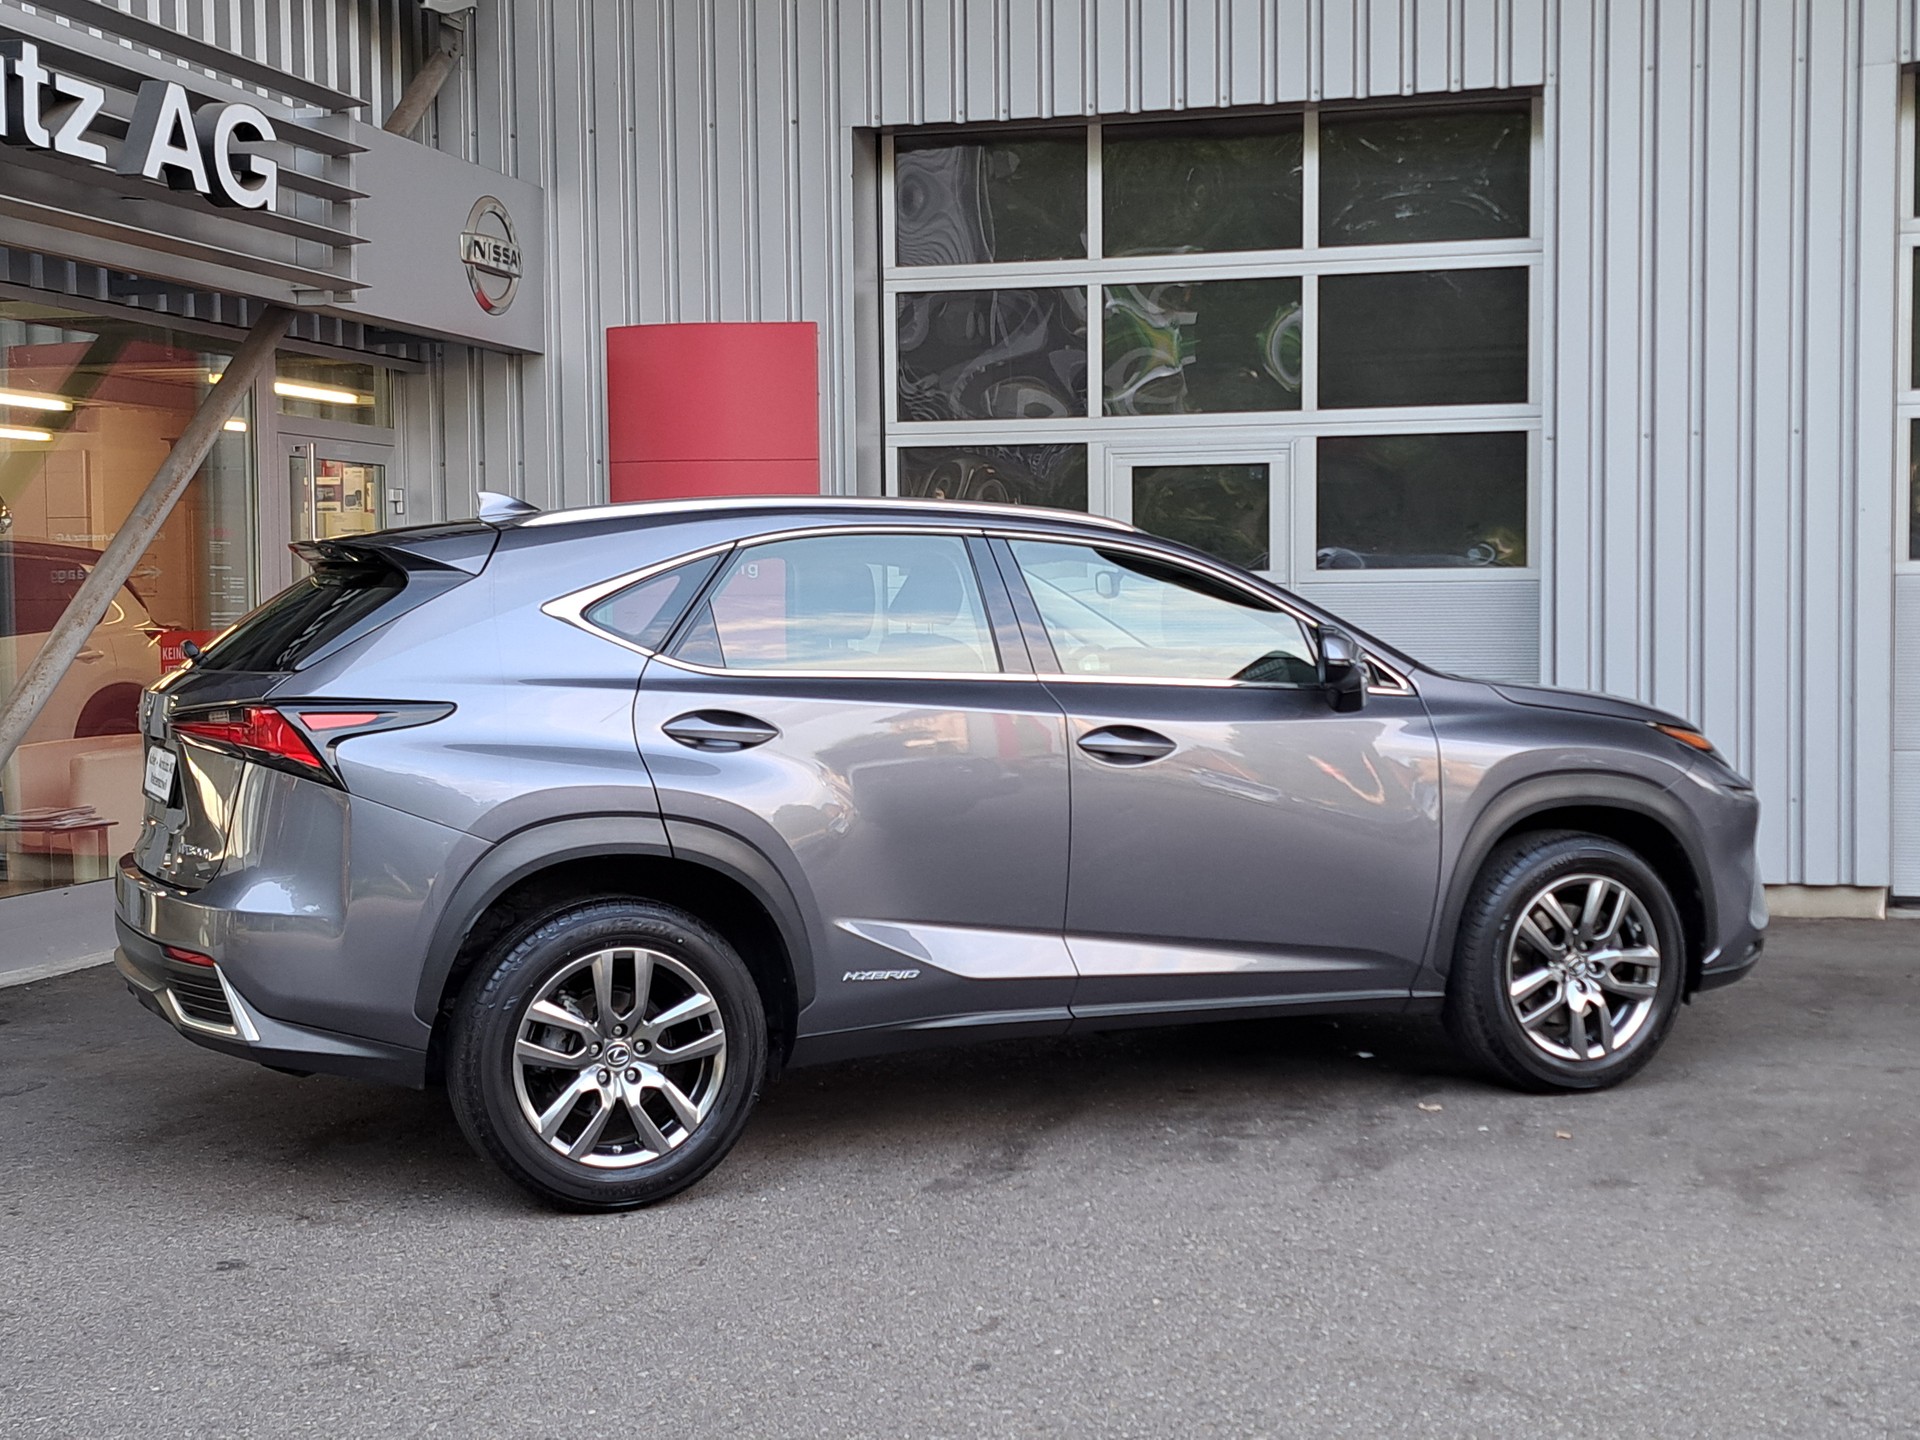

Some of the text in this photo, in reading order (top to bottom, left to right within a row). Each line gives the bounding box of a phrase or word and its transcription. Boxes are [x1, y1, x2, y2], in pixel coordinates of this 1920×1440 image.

[0, 40, 279, 213] tz AG
[842, 969, 921, 982] HYBRID
